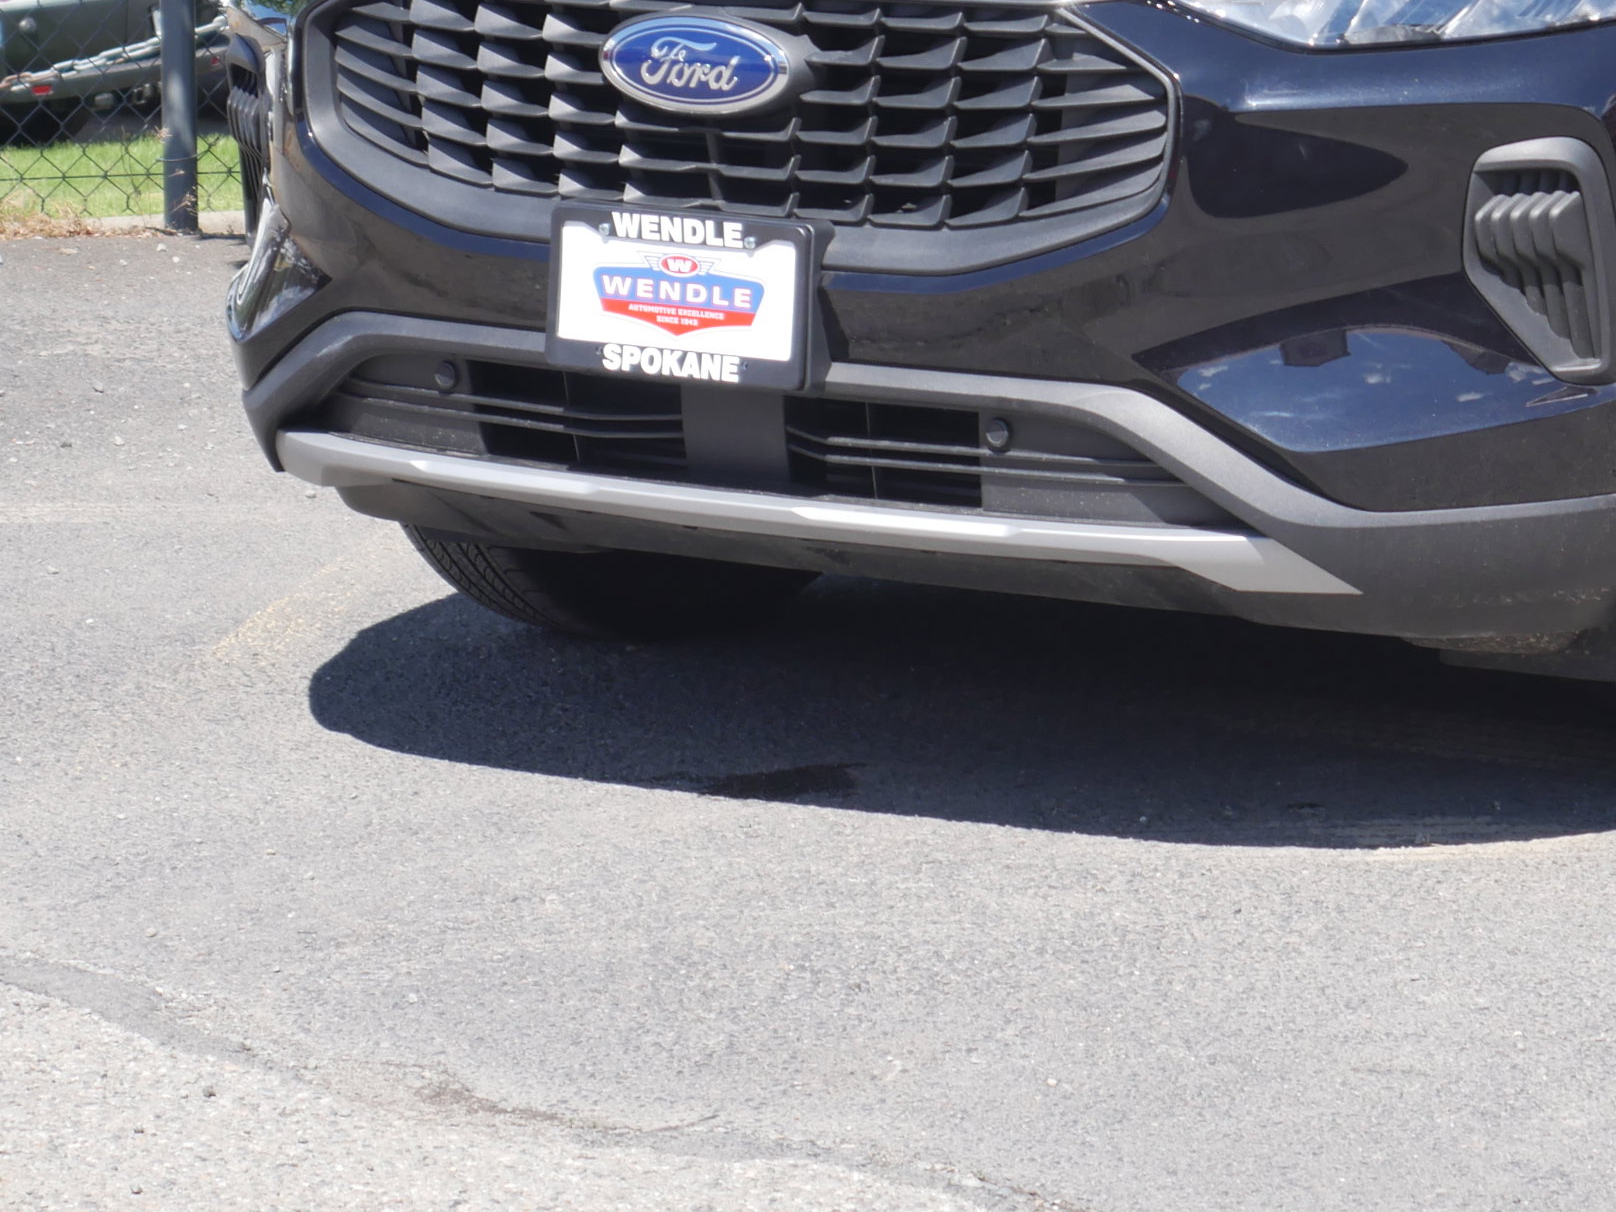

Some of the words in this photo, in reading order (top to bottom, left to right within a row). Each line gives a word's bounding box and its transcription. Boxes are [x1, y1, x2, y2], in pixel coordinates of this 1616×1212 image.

[641, 36, 738, 91] Ford
[612, 211, 744, 248] WENDLE
[667, 258, 693, 273] W
[601, 275, 752, 308] WENDLE
[628, 303, 676, 316] AUTOMOTIVE
[678, 308, 725, 320] EXCELLENCE
[656, 315, 679, 325] SINCE
[602, 343, 739, 382] SPOKANE
